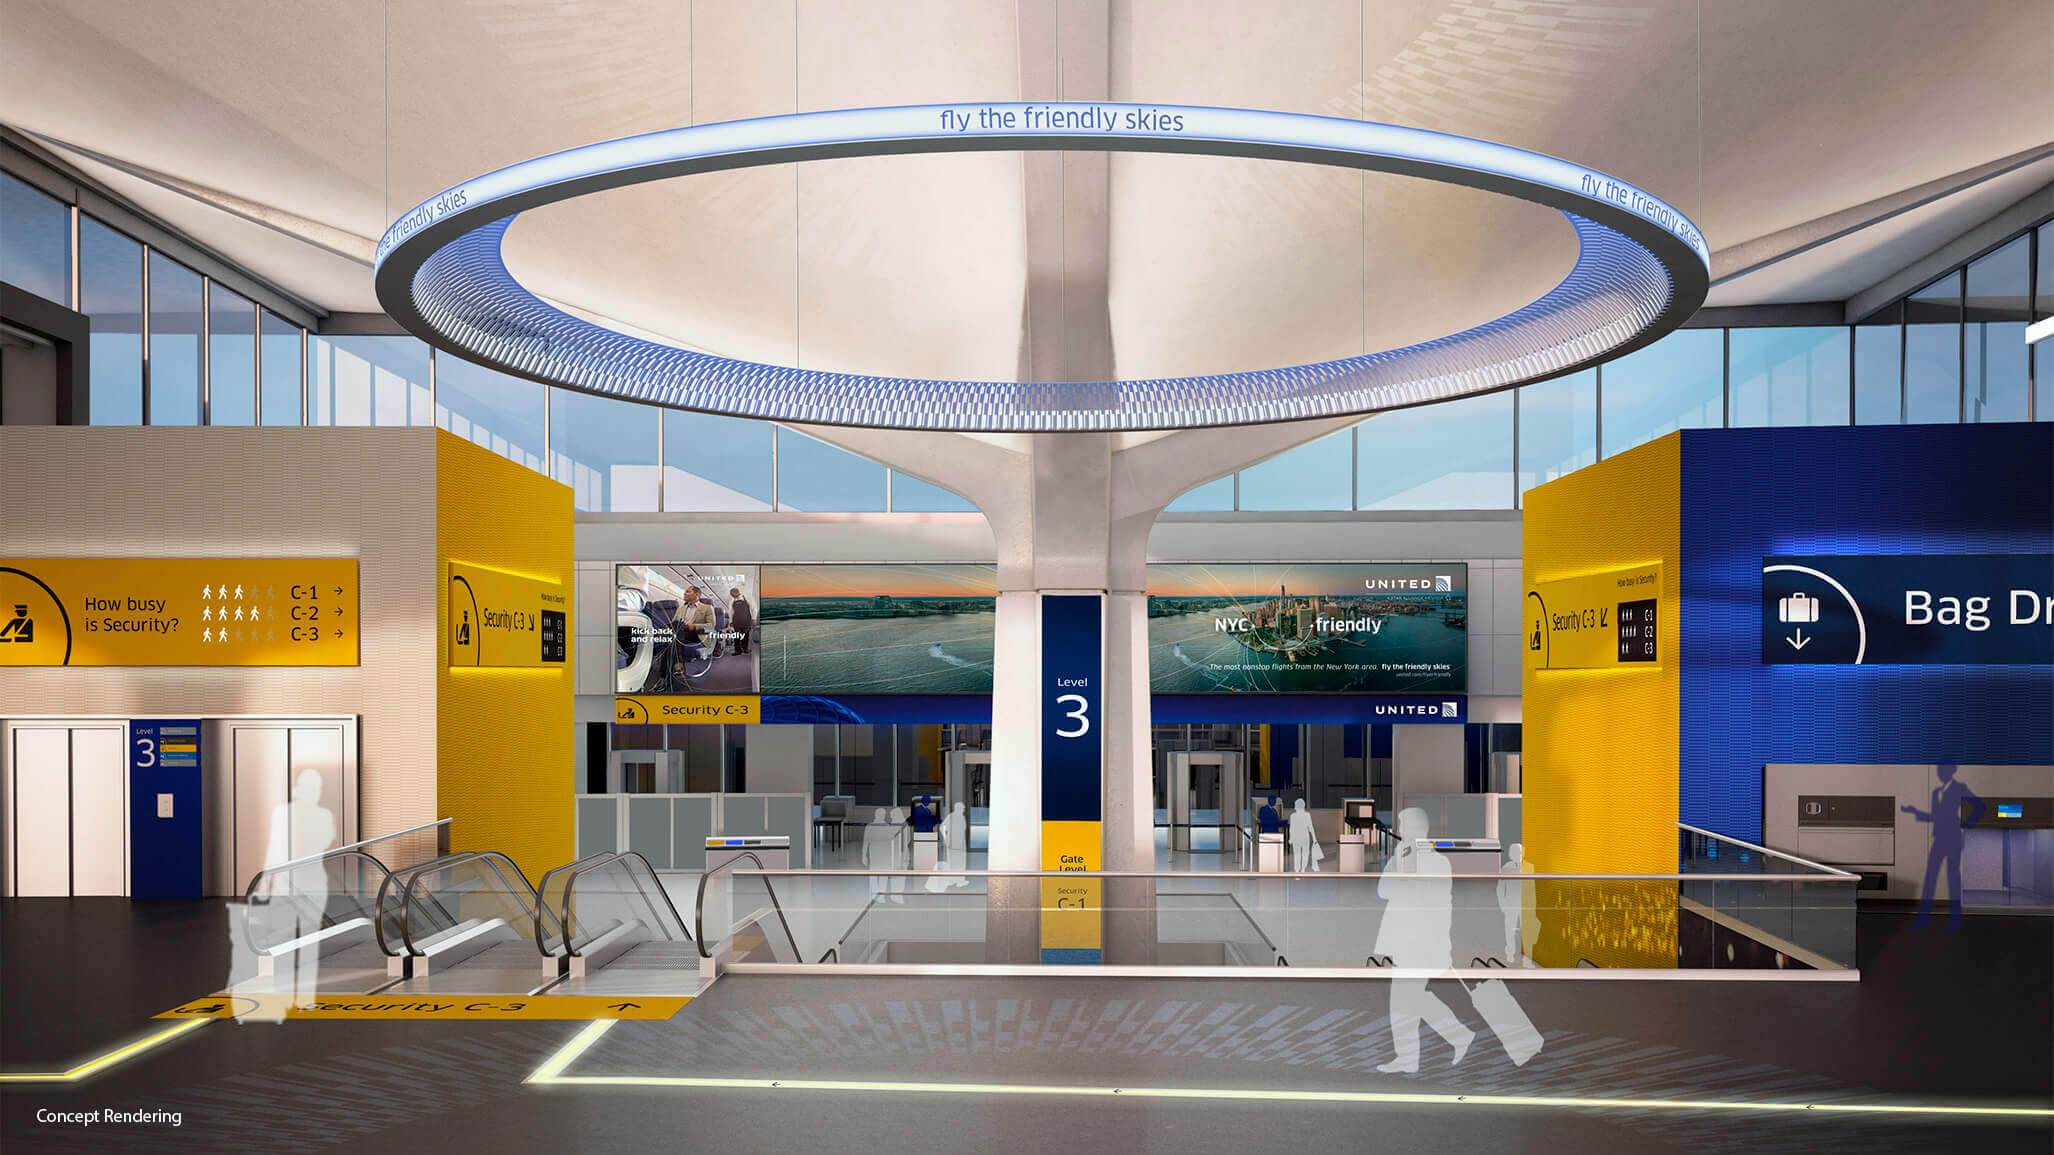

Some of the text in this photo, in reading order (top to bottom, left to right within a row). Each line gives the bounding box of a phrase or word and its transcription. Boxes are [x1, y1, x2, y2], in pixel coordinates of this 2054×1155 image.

[940, 107, 1184, 132] fly the friendly skies
[392, 206, 433, 243] friendly
[436, 189, 467, 216] skies
[1581, 174, 1701, 251] fly the friendly skies
[1365, 579, 1431, 589] UNITED
[291, 585, 318, 600] C-1
[85, 597, 166, 613] How busy
[1905, 589, 1991, 632] Bag
[291, 606, 319, 621] C-2
[483, 607, 525, 632] Security C-3
[1552, 608, 1595, 633] Security C-3
[85, 617, 180, 634] is Security?
[1215, 616, 1382, 634] NYC friendly
[1644, 625, 1654, 638] C-2
[291, 627, 319, 642] C-3
[631, 635, 648, 643] and
[709, 631, 746, 640] friendly
[1644, 642, 1654, 655] C-3
[1209, 663, 1222, 671] The
[1242, 664, 1270, 672] nonstop
[1271, 663, 1293, 672] flights
[1295, 663, 1312, 671] from
[1313, 663, 1325, 671] the
[1326, 663, 1342, 671] New
[1343, 663, 1359, 671] York
[1381, 663, 1391, 671] fly
[1392, 663, 1404, 671] the
[1404, 663, 1432, 672] friendly
[1432, 663, 1450, 671] skies
[1057, 677, 1088, 687] Level
[662, 704, 749, 716] Security C-3
[1055, 694, 1090, 738] 3
[1375, 705, 1438, 715] UNITED
[136, 738, 156, 767] 3
[1060, 855, 1084, 864] Gate
[1057, 897, 1085, 910] C-1
[464, 1002, 527, 1012] C-3
